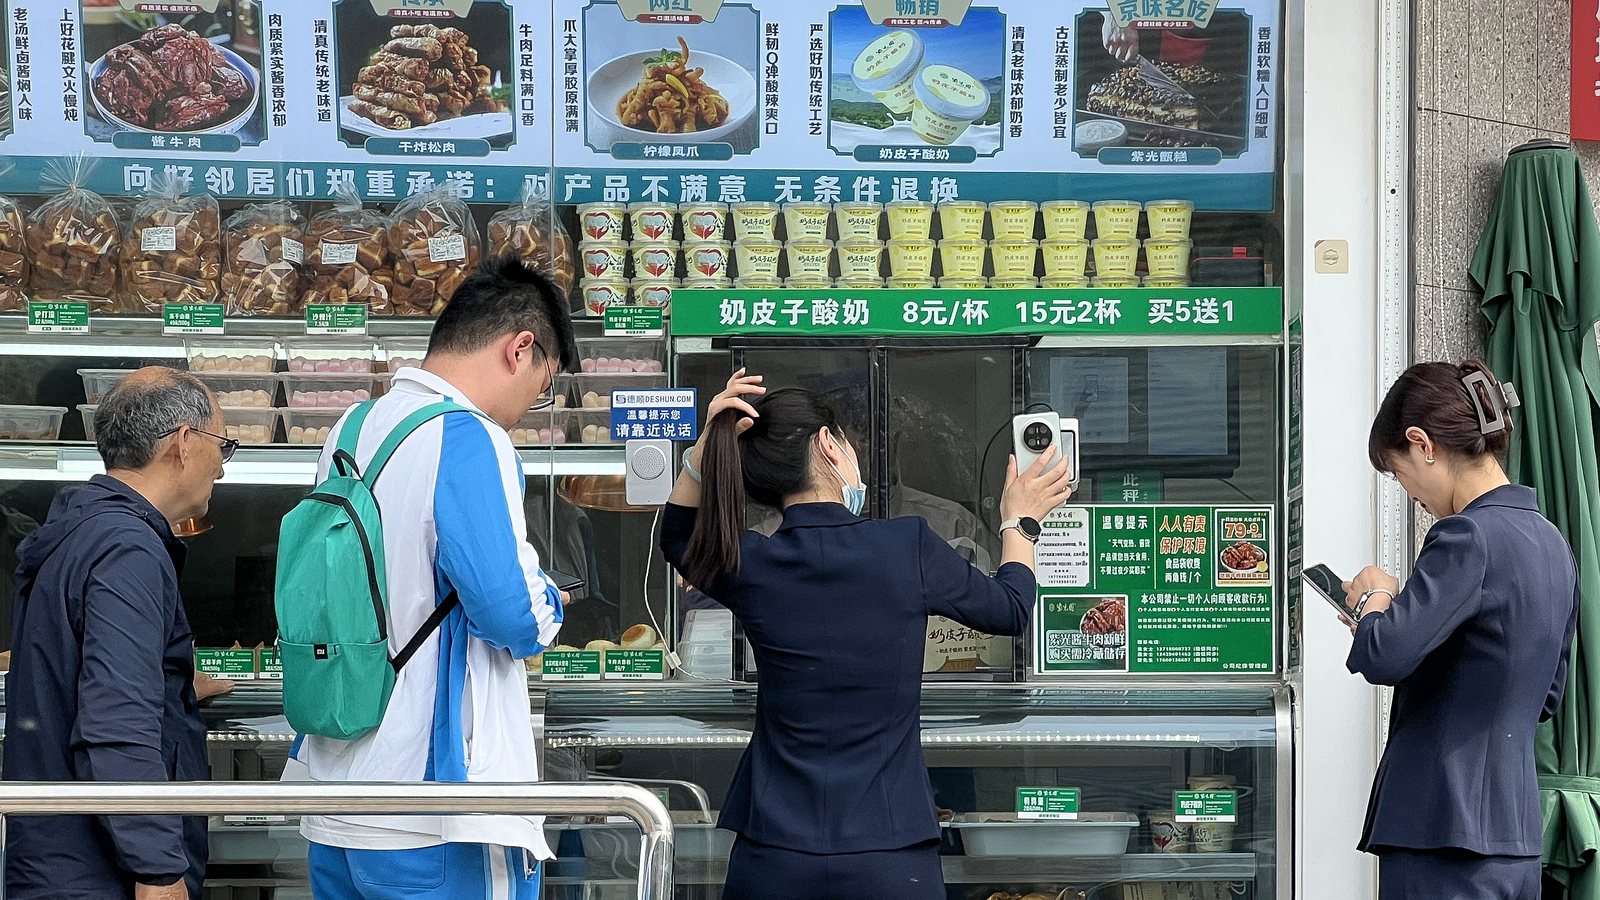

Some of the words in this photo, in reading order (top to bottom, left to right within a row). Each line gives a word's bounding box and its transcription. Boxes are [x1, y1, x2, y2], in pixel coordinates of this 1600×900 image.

[1117, 0, 1210, 22] 京味名吃
[59, 8, 78, 122] 上好花腱文火慢炖
[268, 13, 287, 127] 肉质紧实酱香浓郁
[313, 19, 331, 122] 清真传统老味道
[519, 23, 535, 126] 牛肉足料满口香
[563, 19, 578, 132] 爪大掌厚胶原满满
[765, 23, 779, 135] 鲜韧Q弹酸辣爽口
[809, 23, 823, 135] 严选好奶传统工艺
[1009, 26, 1025, 138] 清真老味浓郁奶香
[1053, 26, 1069, 139] 古法蒸制老少皆宜
[151, 135, 201, 148] 酱牛肉
[399, 141, 456, 154] 干炸松肉
[643, 145, 700, 157] 柠檬凤爪
[879, 148, 950, 160] 奶皮子酸奶
[774, 175, 960, 204] 无条件退换
[719, 299, 870, 326] 奶皮子酸奶
[902, 299, 989, 326] 8元/杯
[1015, 298, 1122, 326] 15元2杯
[1148, 298, 1234, 325] 买5送1
[627, 410, 681, 420] 温馨提示您
[616, 423, 692, 438] 请靠近说话
[1102, 515, 1148, 530] 温馨提示
[1159, 515, 1206, 532] 人人有责
[1225, 523, 1259, 538] 79.9
[1160, 537, 1206, 555] 保护环境
[1165, 558, 1200, 569] 食品袋收费
[928, 628, 994, 644] 奶皮子酸
